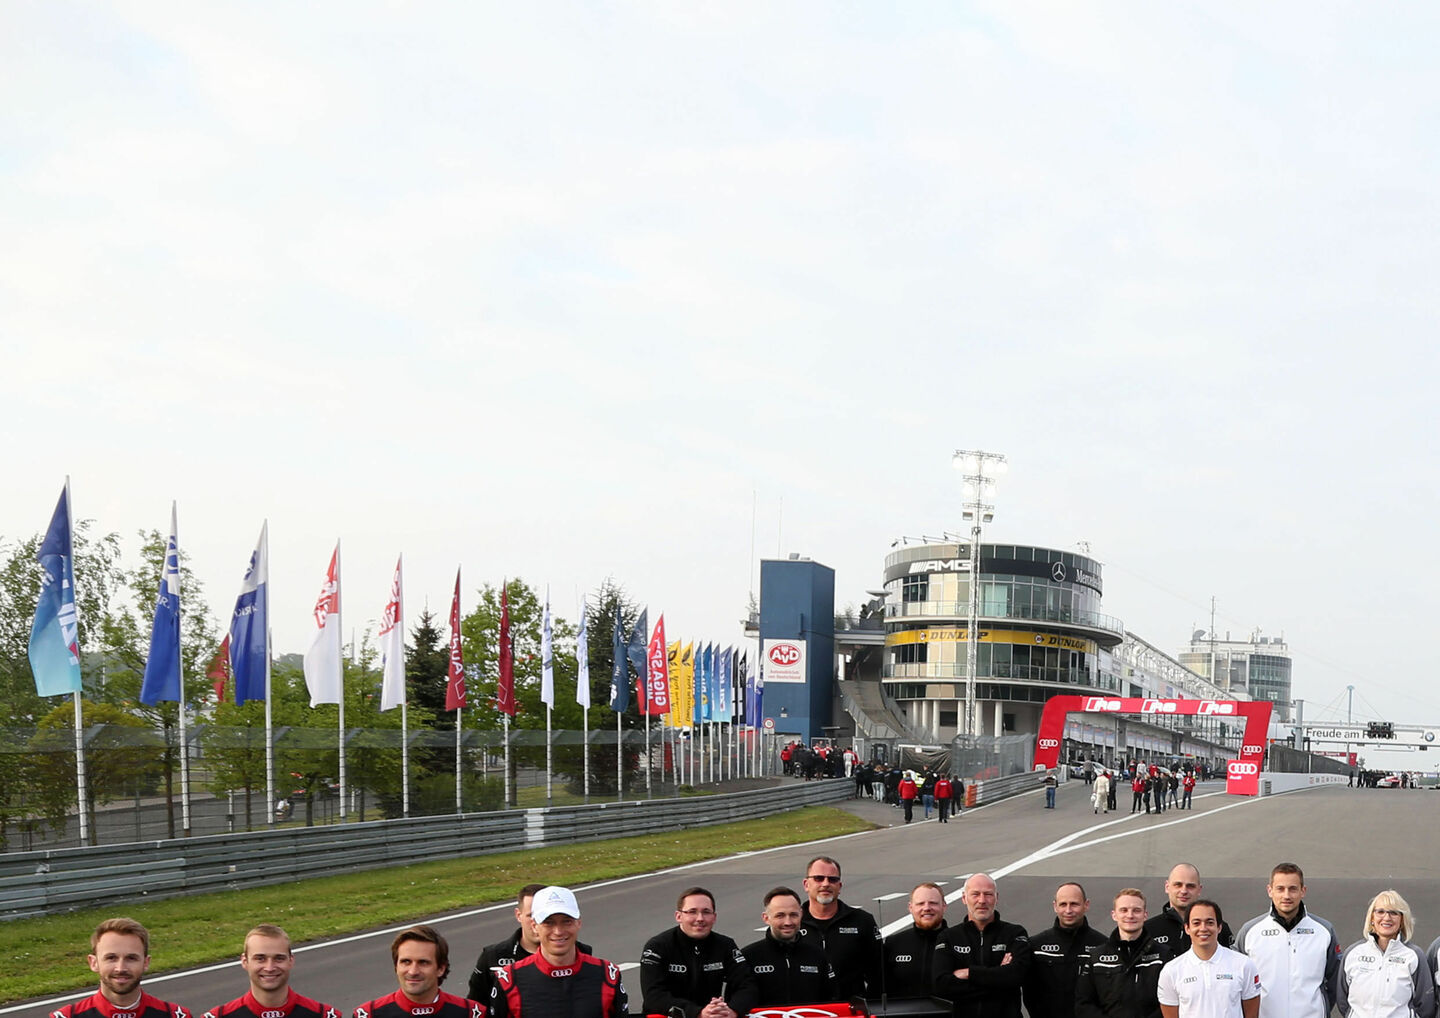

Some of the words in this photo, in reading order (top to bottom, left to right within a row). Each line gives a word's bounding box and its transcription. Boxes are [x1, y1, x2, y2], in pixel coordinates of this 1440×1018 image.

[925, 559, 973, 572] AMG
[929, 630, 989, 640] DUNLOP
[1048, 636, 1086, 649] DUNLOP
[1306, 728, 1343, 740] Freude
[1344, 731, 1360, 740] am
